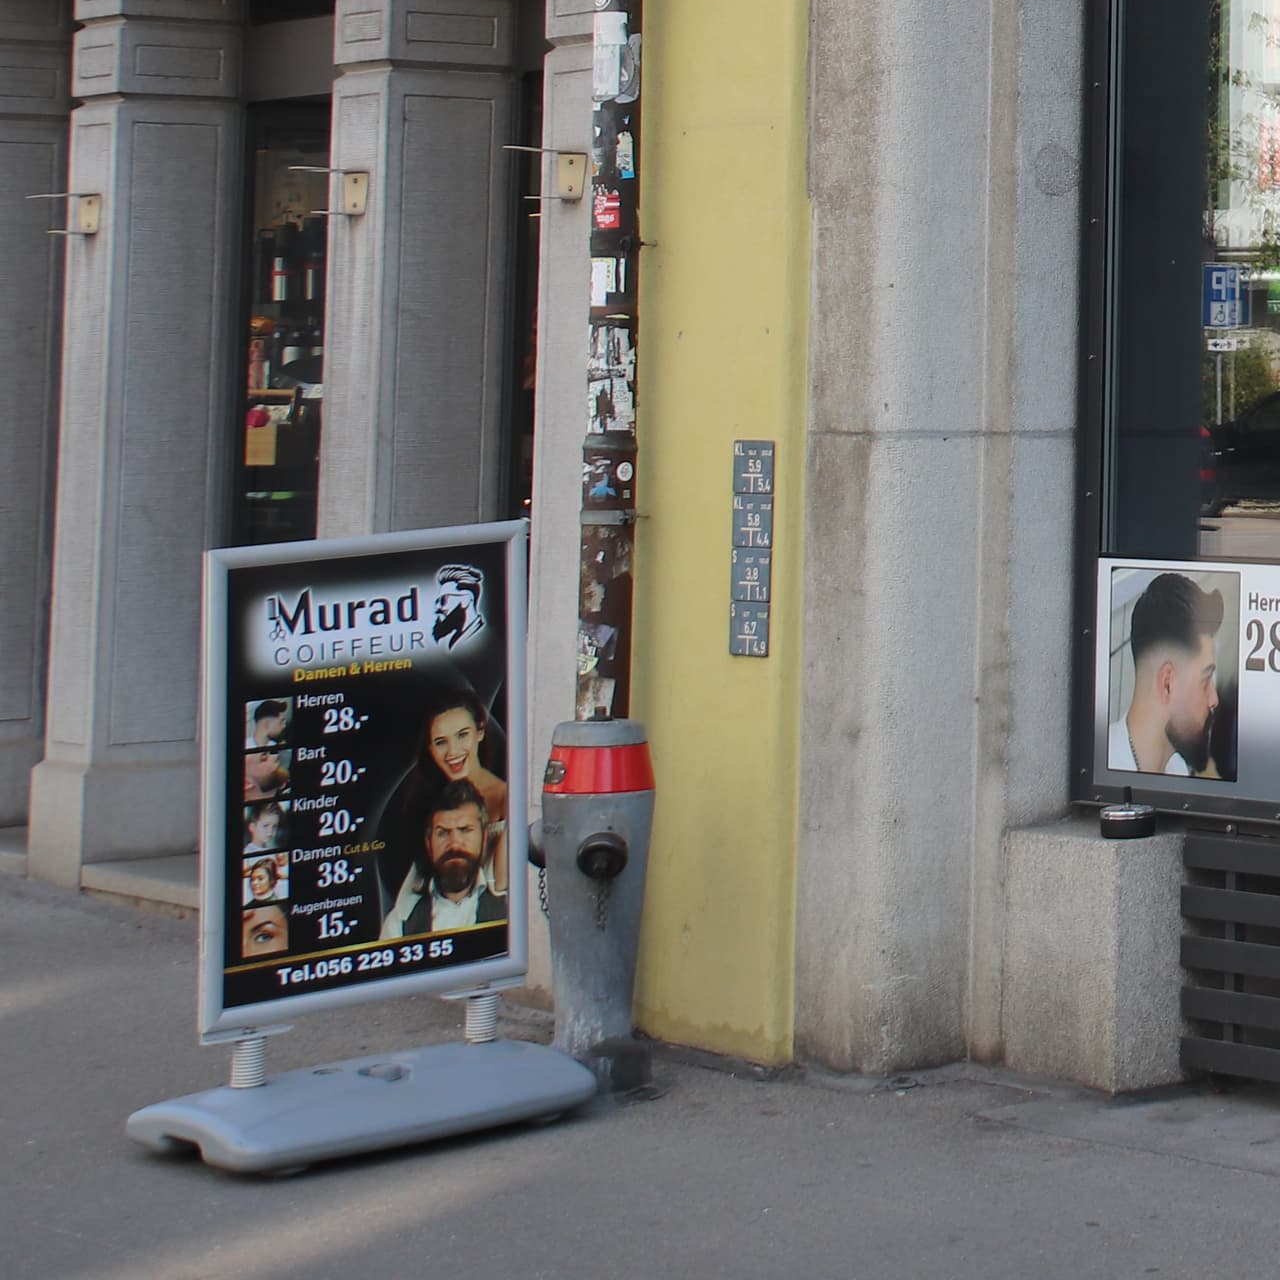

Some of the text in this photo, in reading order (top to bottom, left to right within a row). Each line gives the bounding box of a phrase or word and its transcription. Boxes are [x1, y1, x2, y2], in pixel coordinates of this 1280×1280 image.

[735, 442, 744, 456] KL
[734, 496, 743, 510] KL
[273, 587, 420, 637] Murad
[274, 631, 425, 666] COIFFEUR
[293, 658, 412, 682] Damen & Herren
[297, 691, 344, 709] Herren
[323, 706, 369, 734] 28.-
[297, 744, 327, 761] Bart
[320, 760, 366, 787] 20.-
[293, 793, 339, 812] Kinder
[318, 810, 364, 837] 20.-
[292, 839, 386, 864] Damen Cut & Go
[292, 894, 363, 916] Augenbrauen
[277, 938, 454, 986] Tel.056 229 33 55
